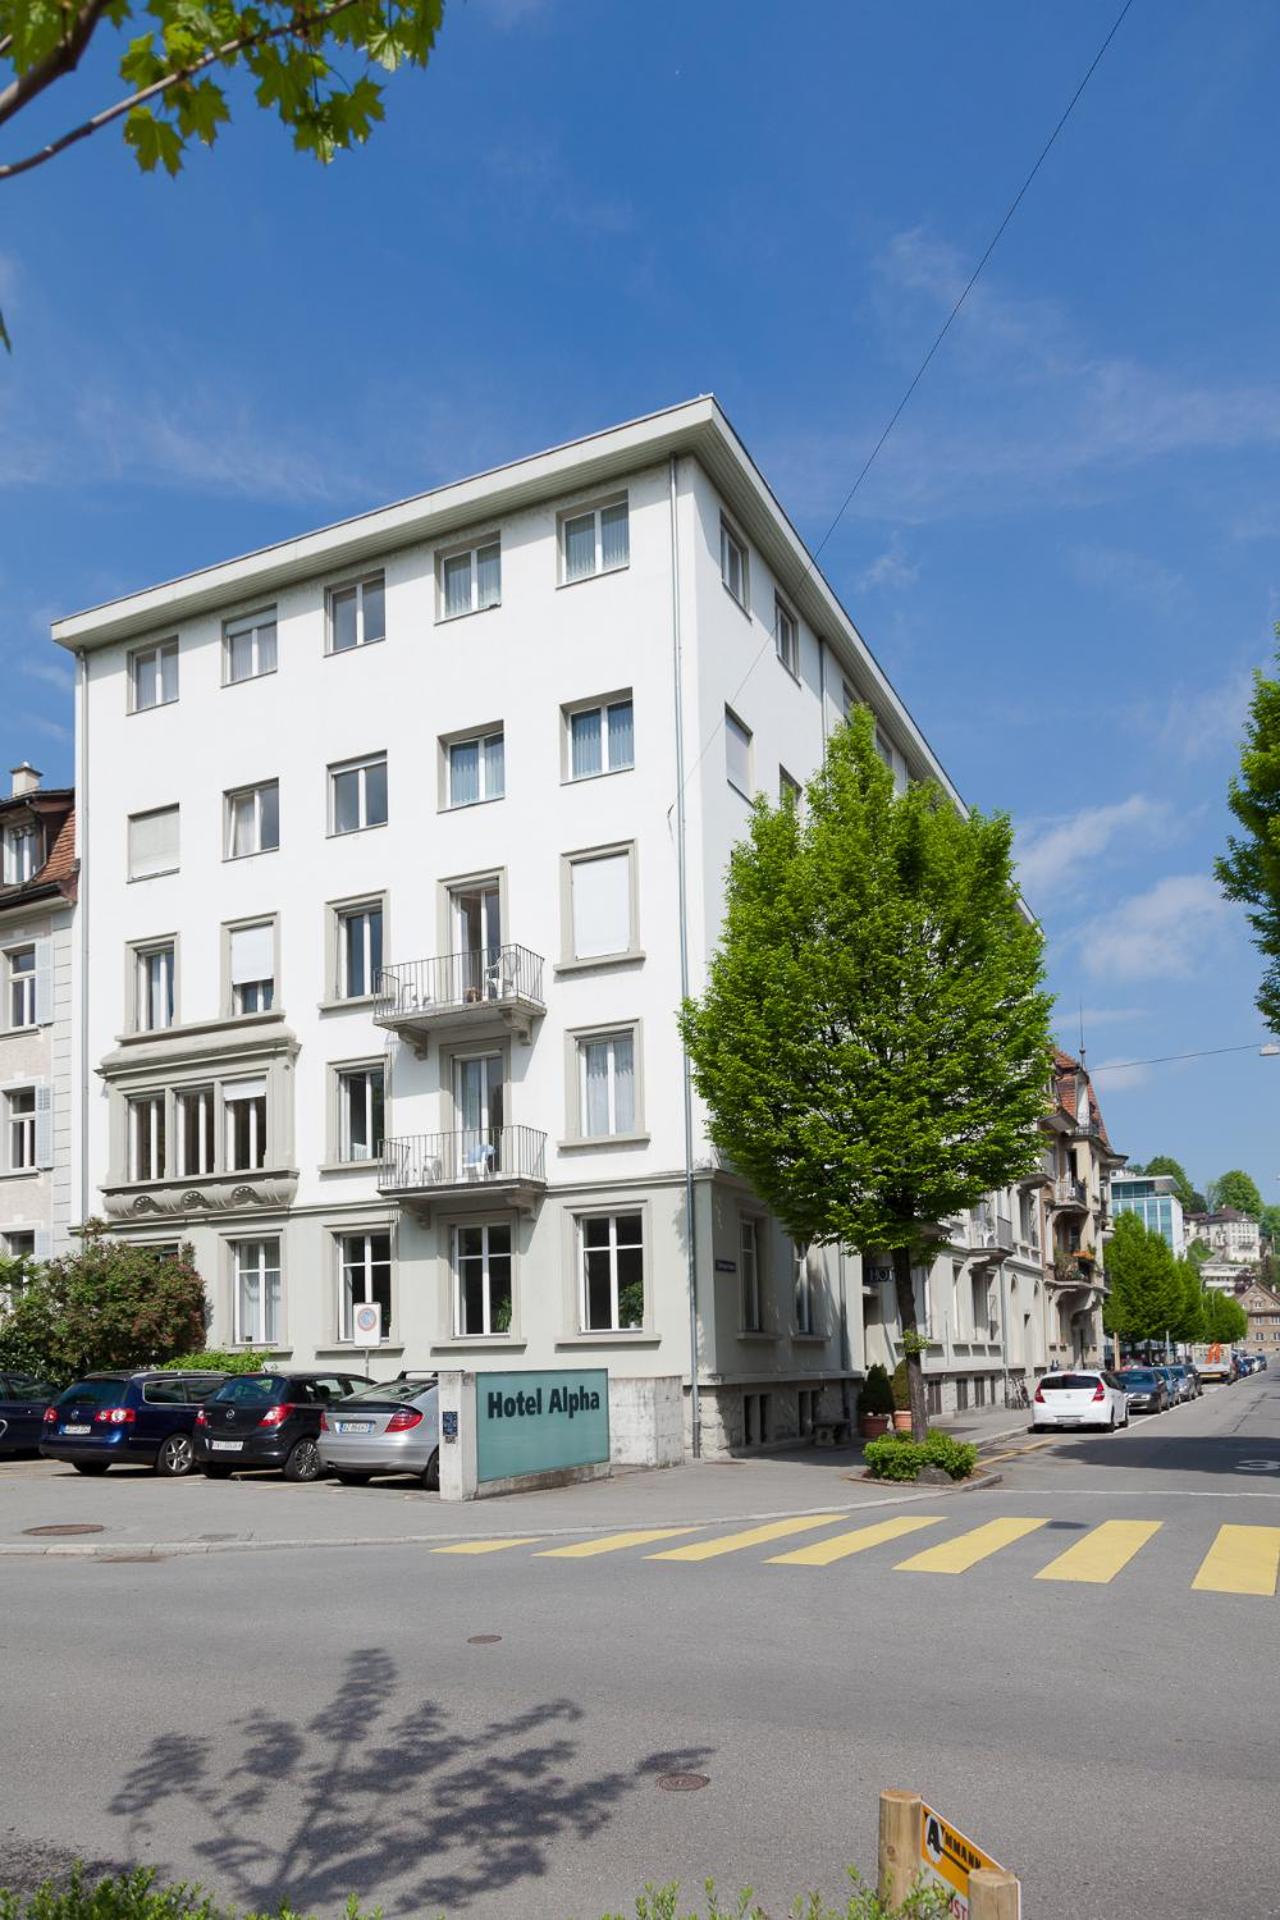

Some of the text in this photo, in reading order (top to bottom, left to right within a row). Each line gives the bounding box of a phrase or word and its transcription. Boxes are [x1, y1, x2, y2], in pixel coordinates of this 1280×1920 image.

[488, 1385, 600, 1419] Hotel Alpha
[1233, 1458, 1280, 1471] 3
